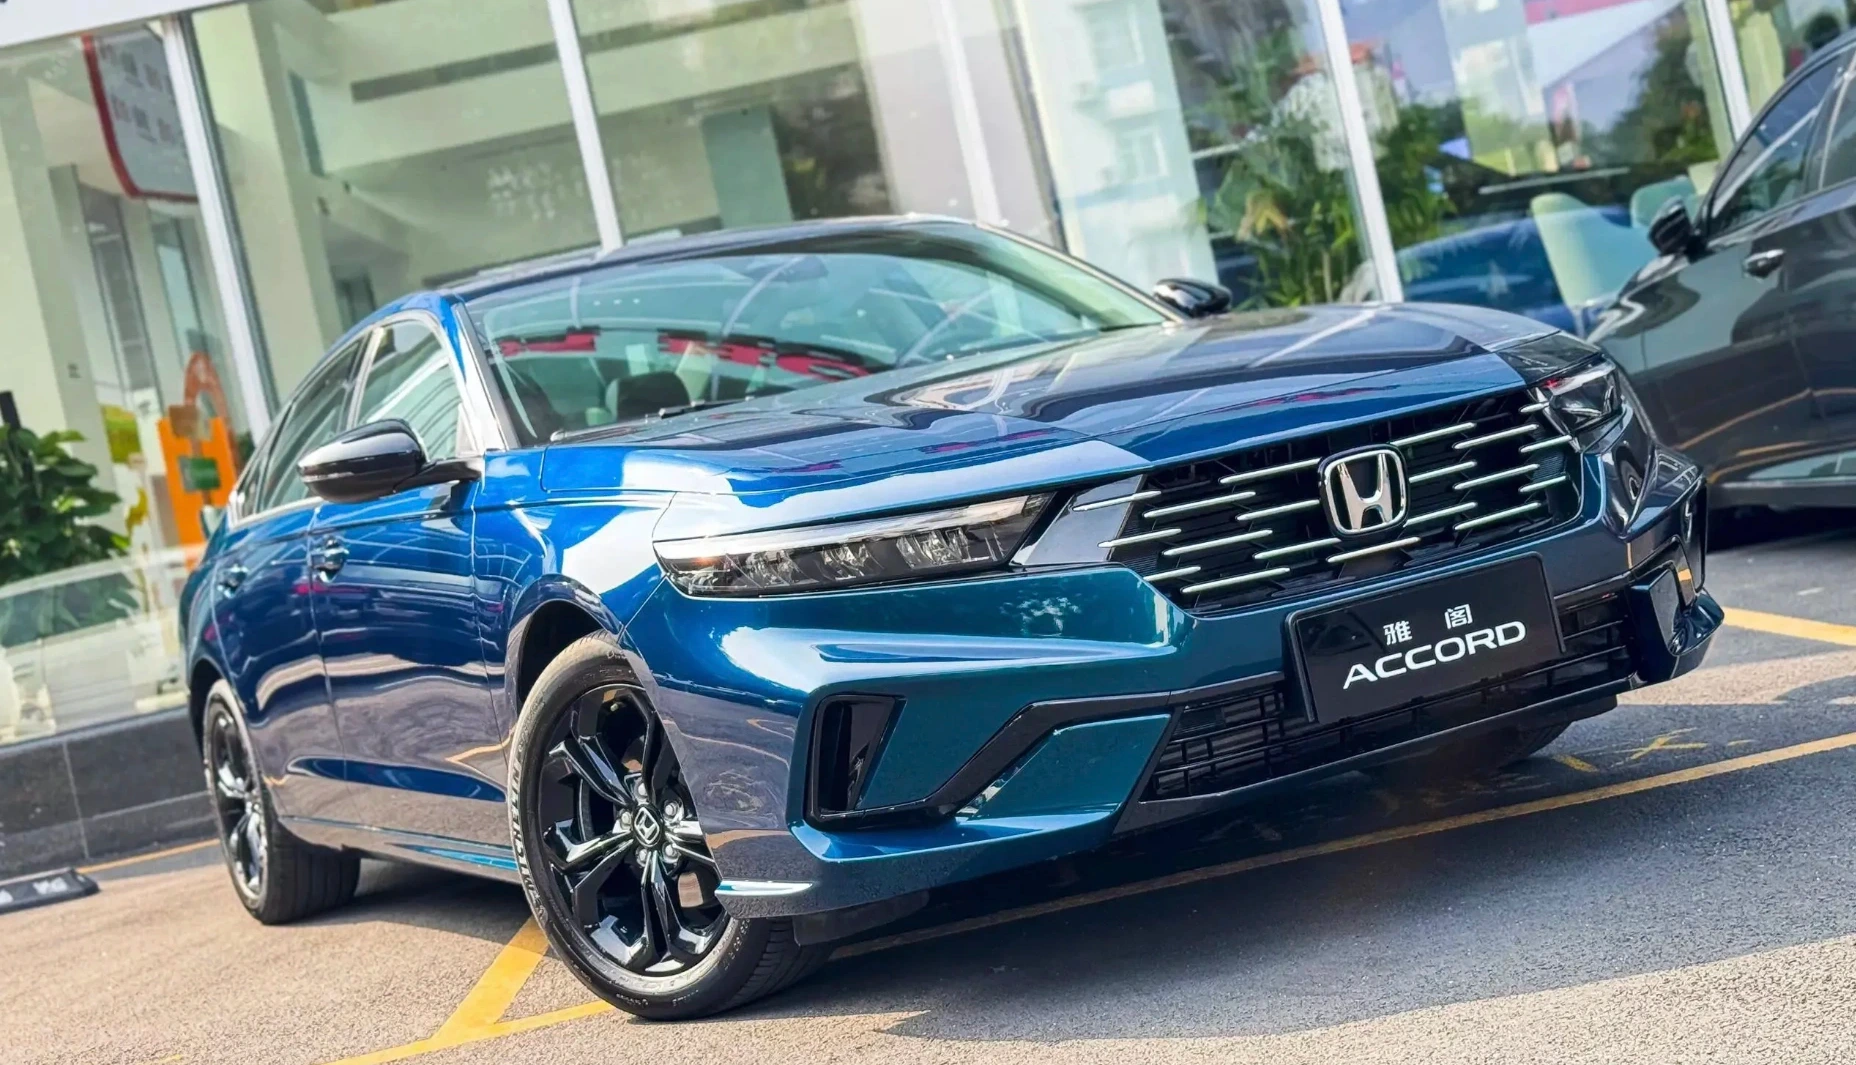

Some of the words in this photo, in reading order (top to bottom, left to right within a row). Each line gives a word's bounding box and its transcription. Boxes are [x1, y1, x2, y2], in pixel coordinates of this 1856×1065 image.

[1342, 620, 1527, 690] ACCORD
[1382, 603, 1474, 646] 雅阁
[511, 757, 539, 894] MICHELIN
